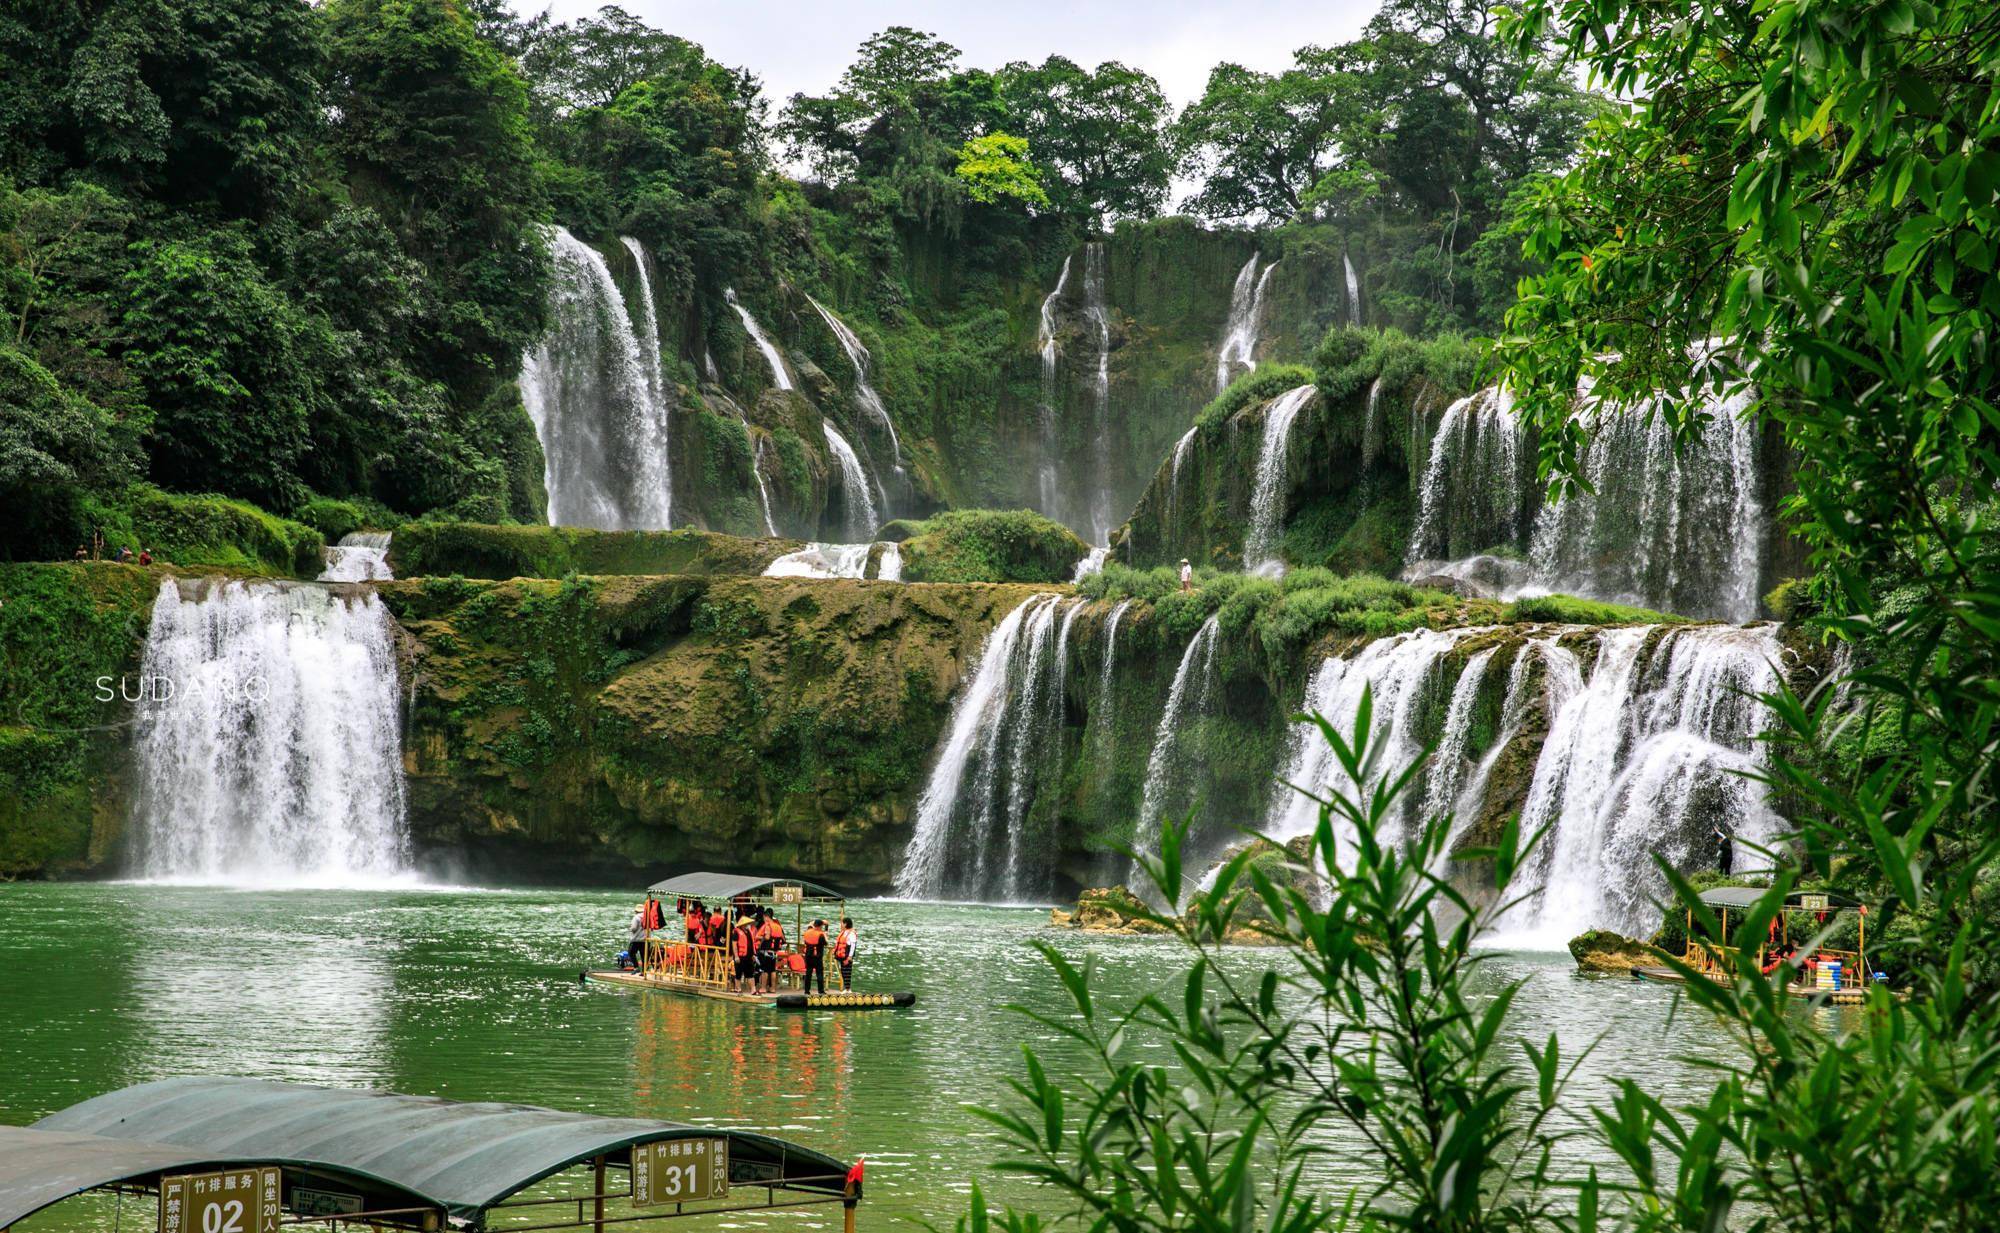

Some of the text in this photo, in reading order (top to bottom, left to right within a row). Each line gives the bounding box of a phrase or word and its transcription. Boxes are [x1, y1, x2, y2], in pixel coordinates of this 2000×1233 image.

[782, 893, 794, 902] 30
[657, 1142, 705, 1158] 竹排服务
[636, 1148, 648, 1201] 严禁游泳
[665, 1164, 697, 1196] 31
[713, 1141, 725, 1193] 限坐20人
[195, 1174, 253, 1194] 竹排服务
[165, 1184, 182, 1233] 严禁游
[202, 1200, 244, 1233] 02
[263, 1172, 277, 1232] 限坐20人
